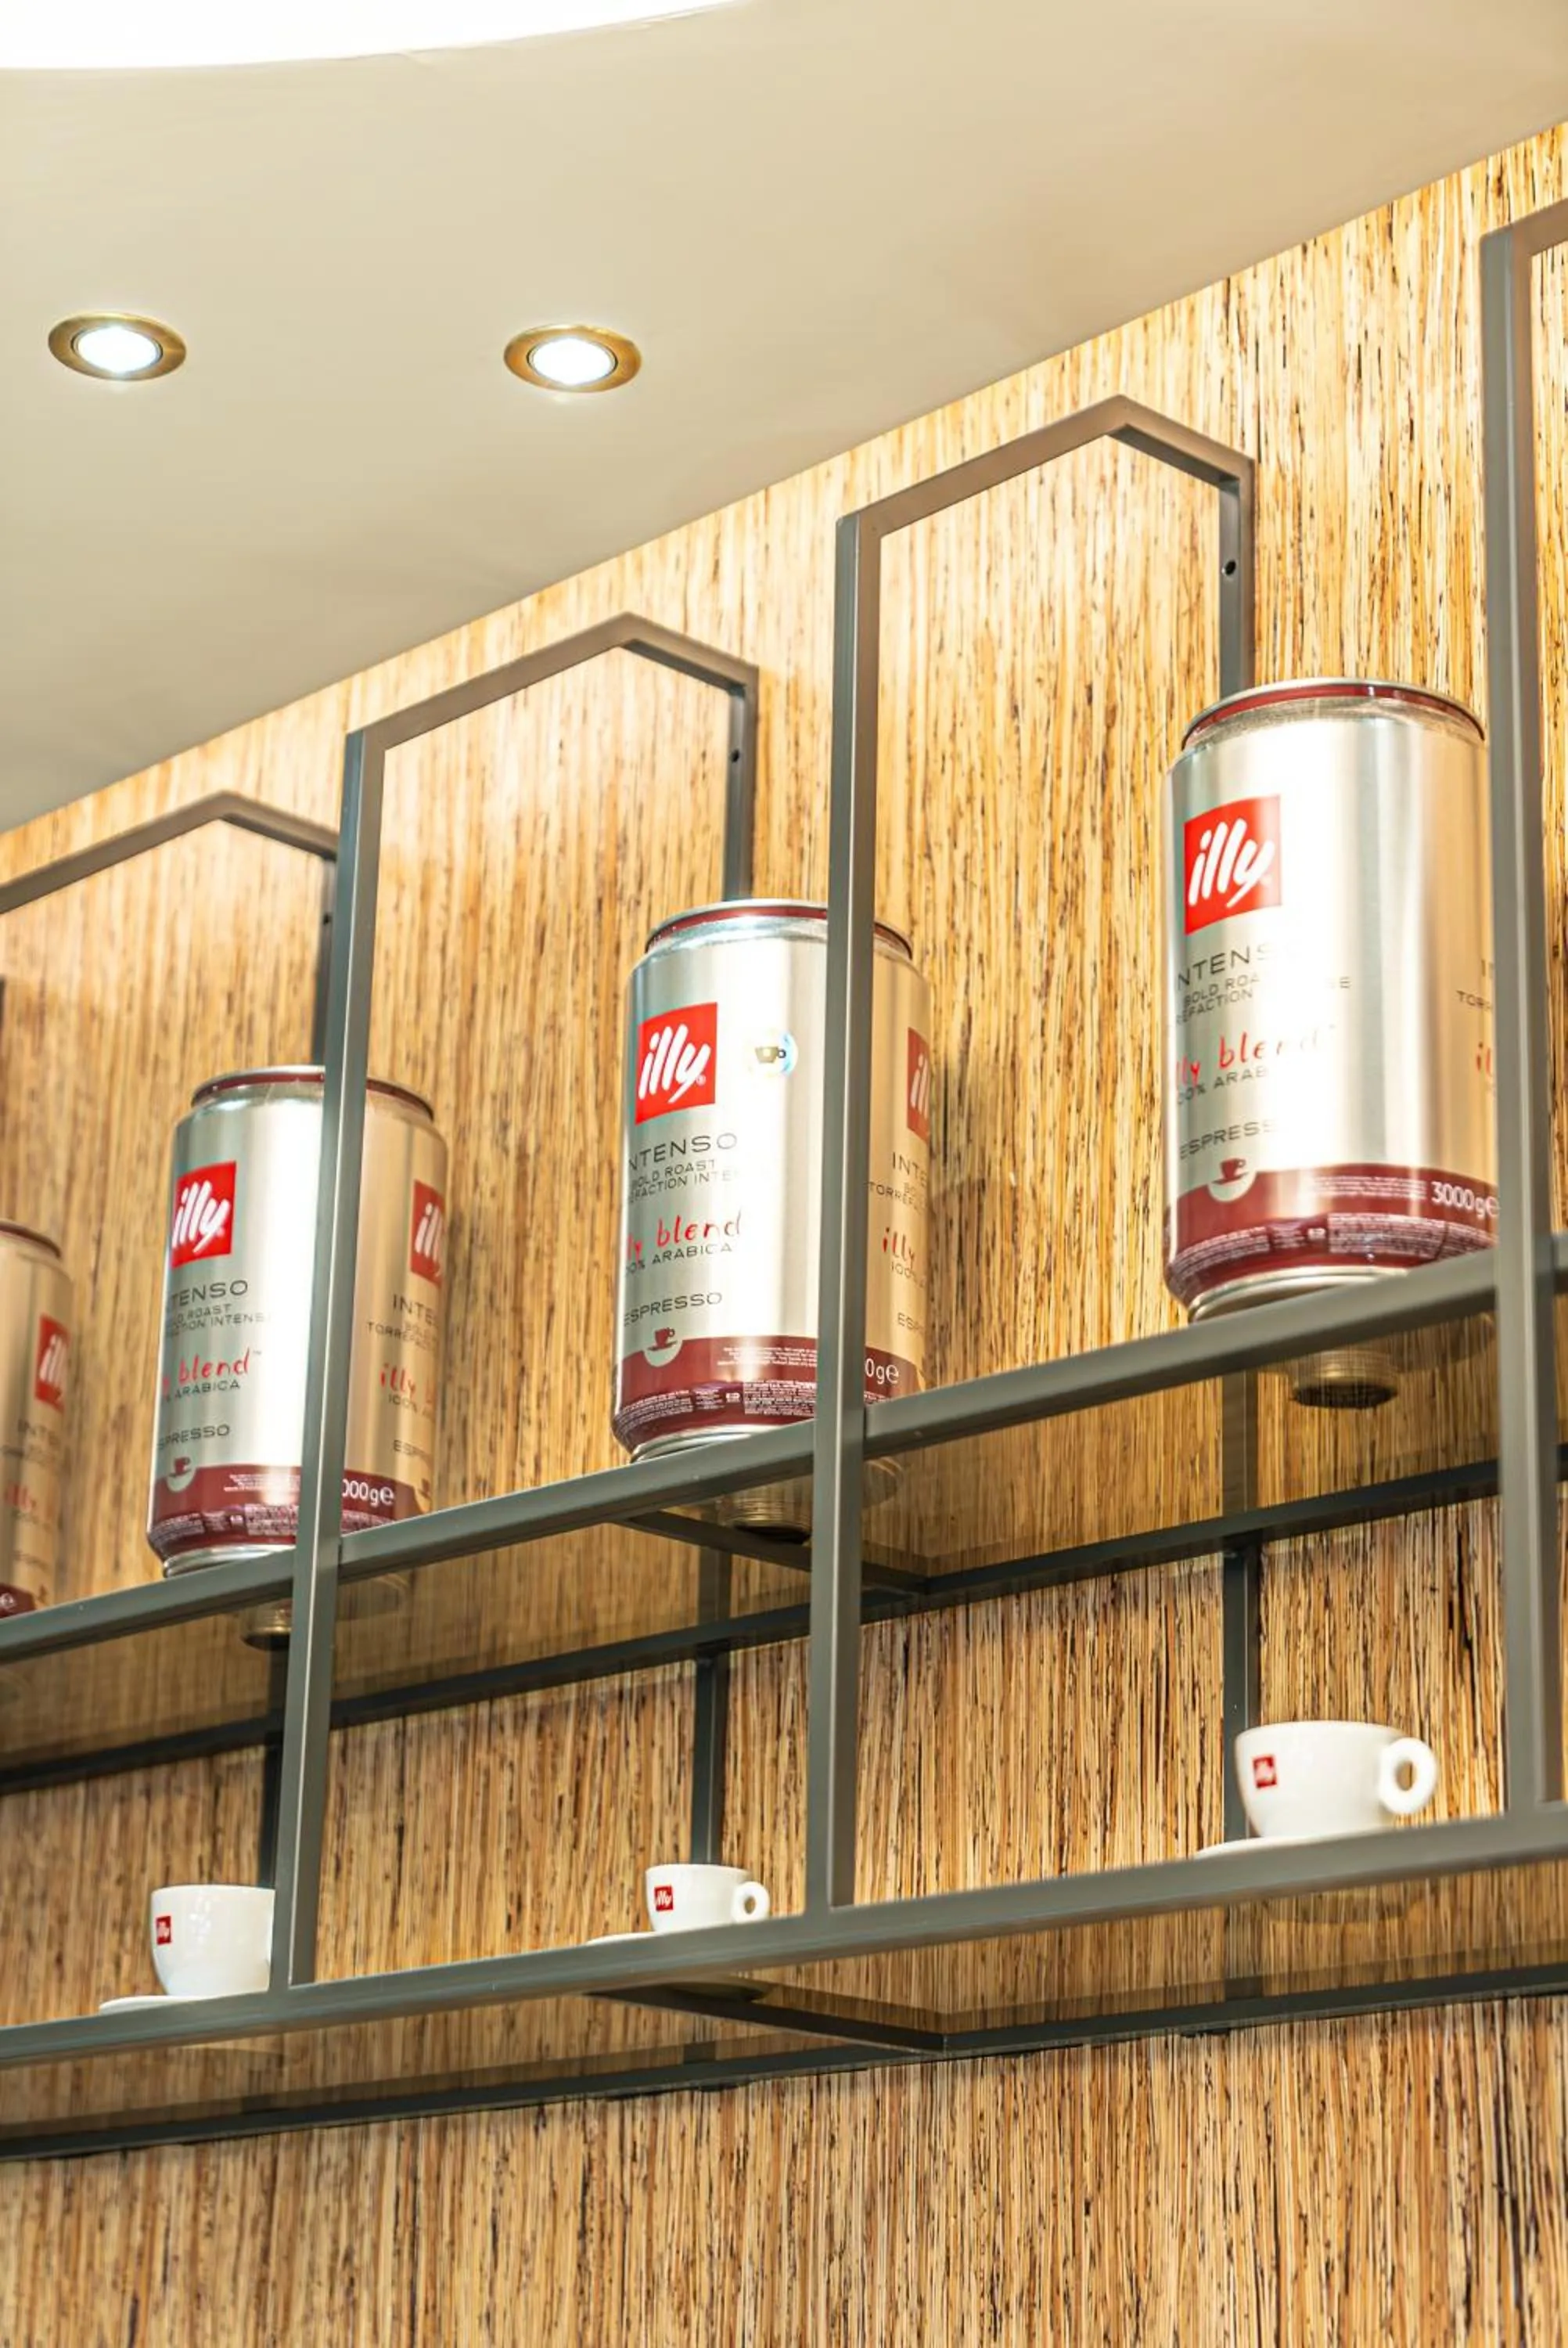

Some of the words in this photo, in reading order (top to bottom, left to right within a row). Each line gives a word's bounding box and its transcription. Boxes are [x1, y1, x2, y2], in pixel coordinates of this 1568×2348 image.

[1188, 818, 1275, 908] illy
[638, 1023, 711, 1104] illy
[910, 1053, 930, 1121] ill
[628, 1133, 737, 1171] NTENSO
[1179, 1119, 1278, 1160] ESPRESS
[892, 1151, 927, 1187] INTE
[172, 1179, 230, 1253] illy
[653, 1242, 732, 1265] ARABICA
[171, 1280, 248, 1307] TENSO
[393, 1294, 433, 1325] INTE
[178, 1347, 250, 1385] blend
[157, 1424, 230, 1450] SPRESSO
